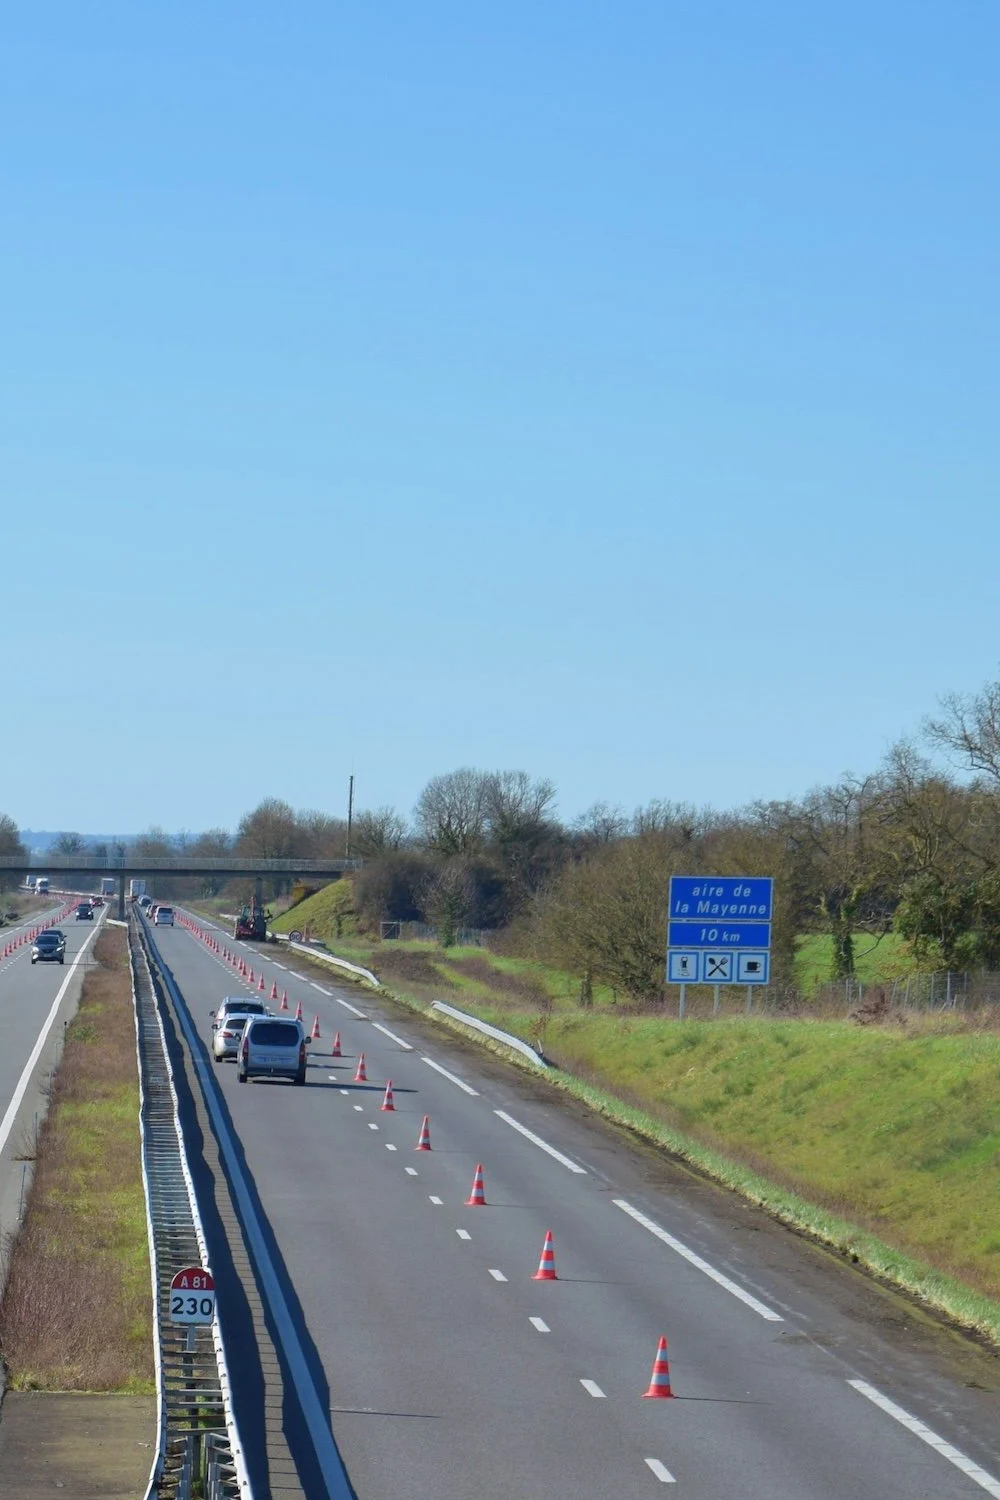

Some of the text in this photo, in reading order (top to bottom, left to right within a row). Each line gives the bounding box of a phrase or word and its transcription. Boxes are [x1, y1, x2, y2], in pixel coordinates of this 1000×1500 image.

[692, 883, 751, 897] aire de
[675, 900, 766, 916] la Mayenne
[700, 928, 741, 942] 10 km
[180, 1275, 207, 1289] A 81
[171, 1296, 213, 1316] 230
